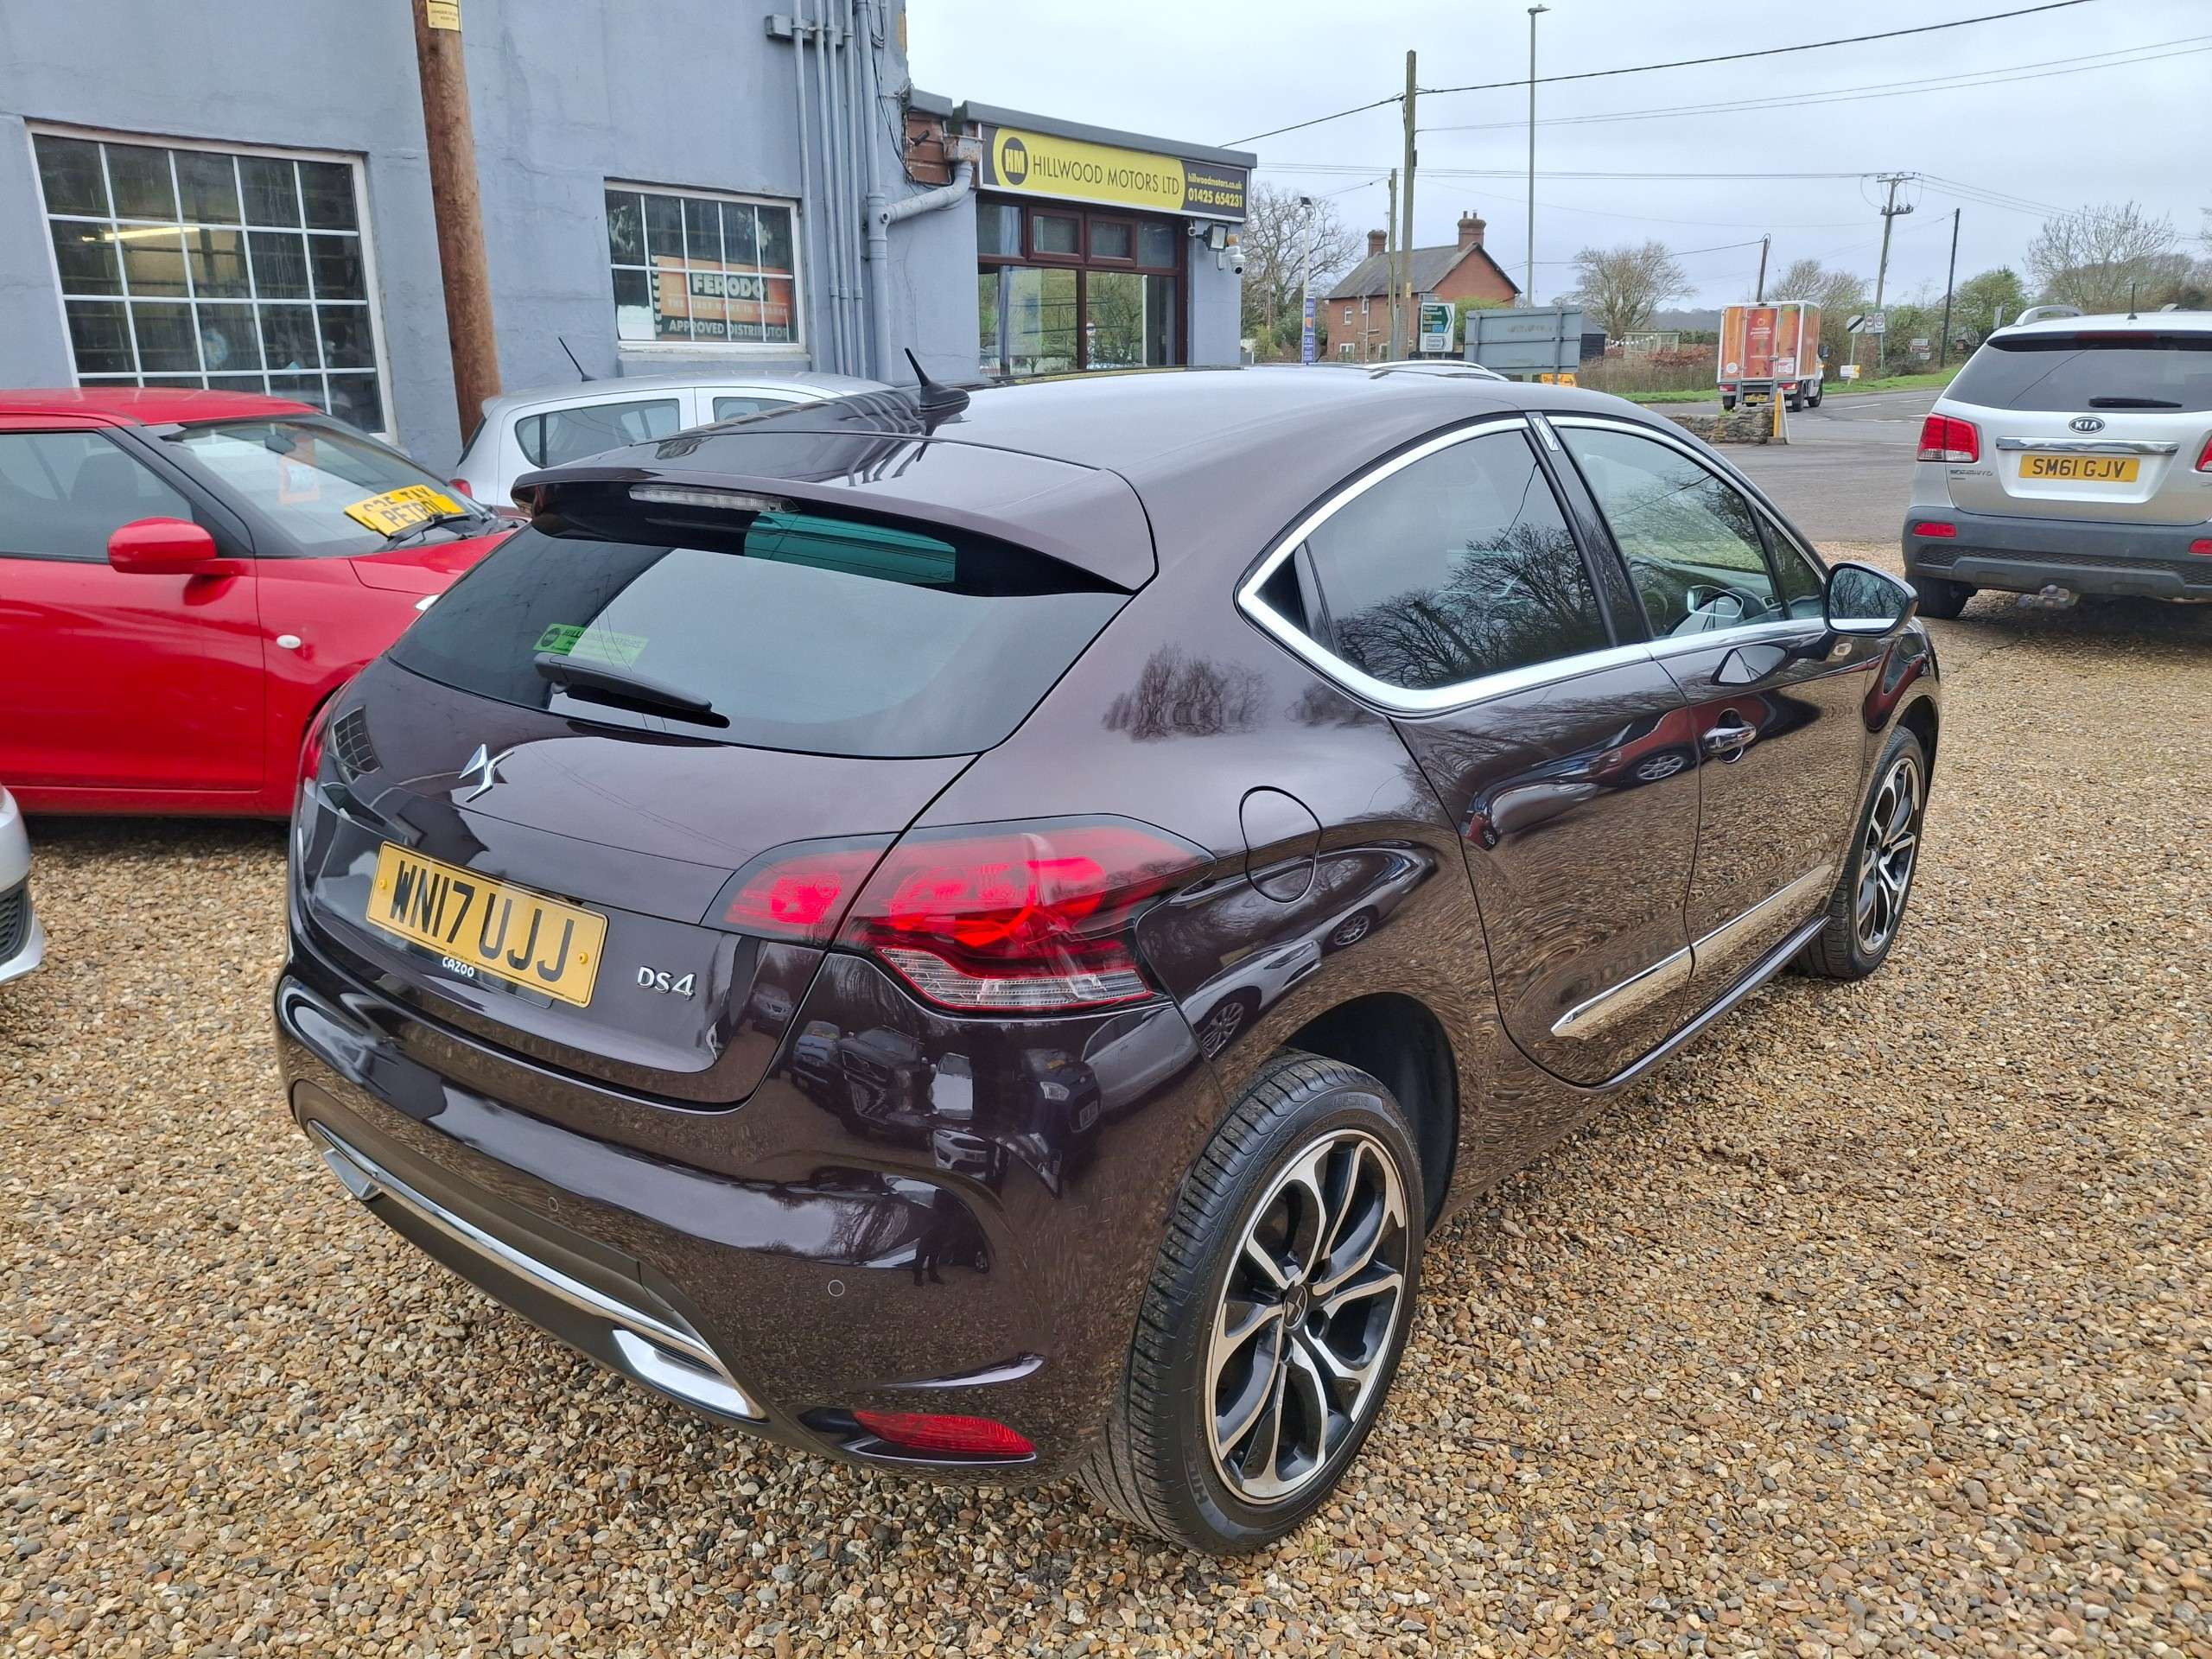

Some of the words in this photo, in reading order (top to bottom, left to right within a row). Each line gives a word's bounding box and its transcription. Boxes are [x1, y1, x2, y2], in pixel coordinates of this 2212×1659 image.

[1005, 148, 1025, 174] HM
[1033, 155, 1103, 184] HILLWOOD
[1108, 169, 1159, 194] MOTORS
[1162, 175, 1179, 195] LTD
[1188, 188, 1213, 204] 01425
[1214, 191, 1243, 208] 654231
[692, 273, 766, 298] FERODO
[668, 320, 725, 335] APPROVED
[2075, 420, 2098, 430] KIA
[2031, 458, 2077, 477] SM61
[2083, 461, 2126, 479] GJV
[390, 860, 475, 943] WN17
[479, 893, 575, 982] UJJ
[442, 956, 474, 977] CAZOO
